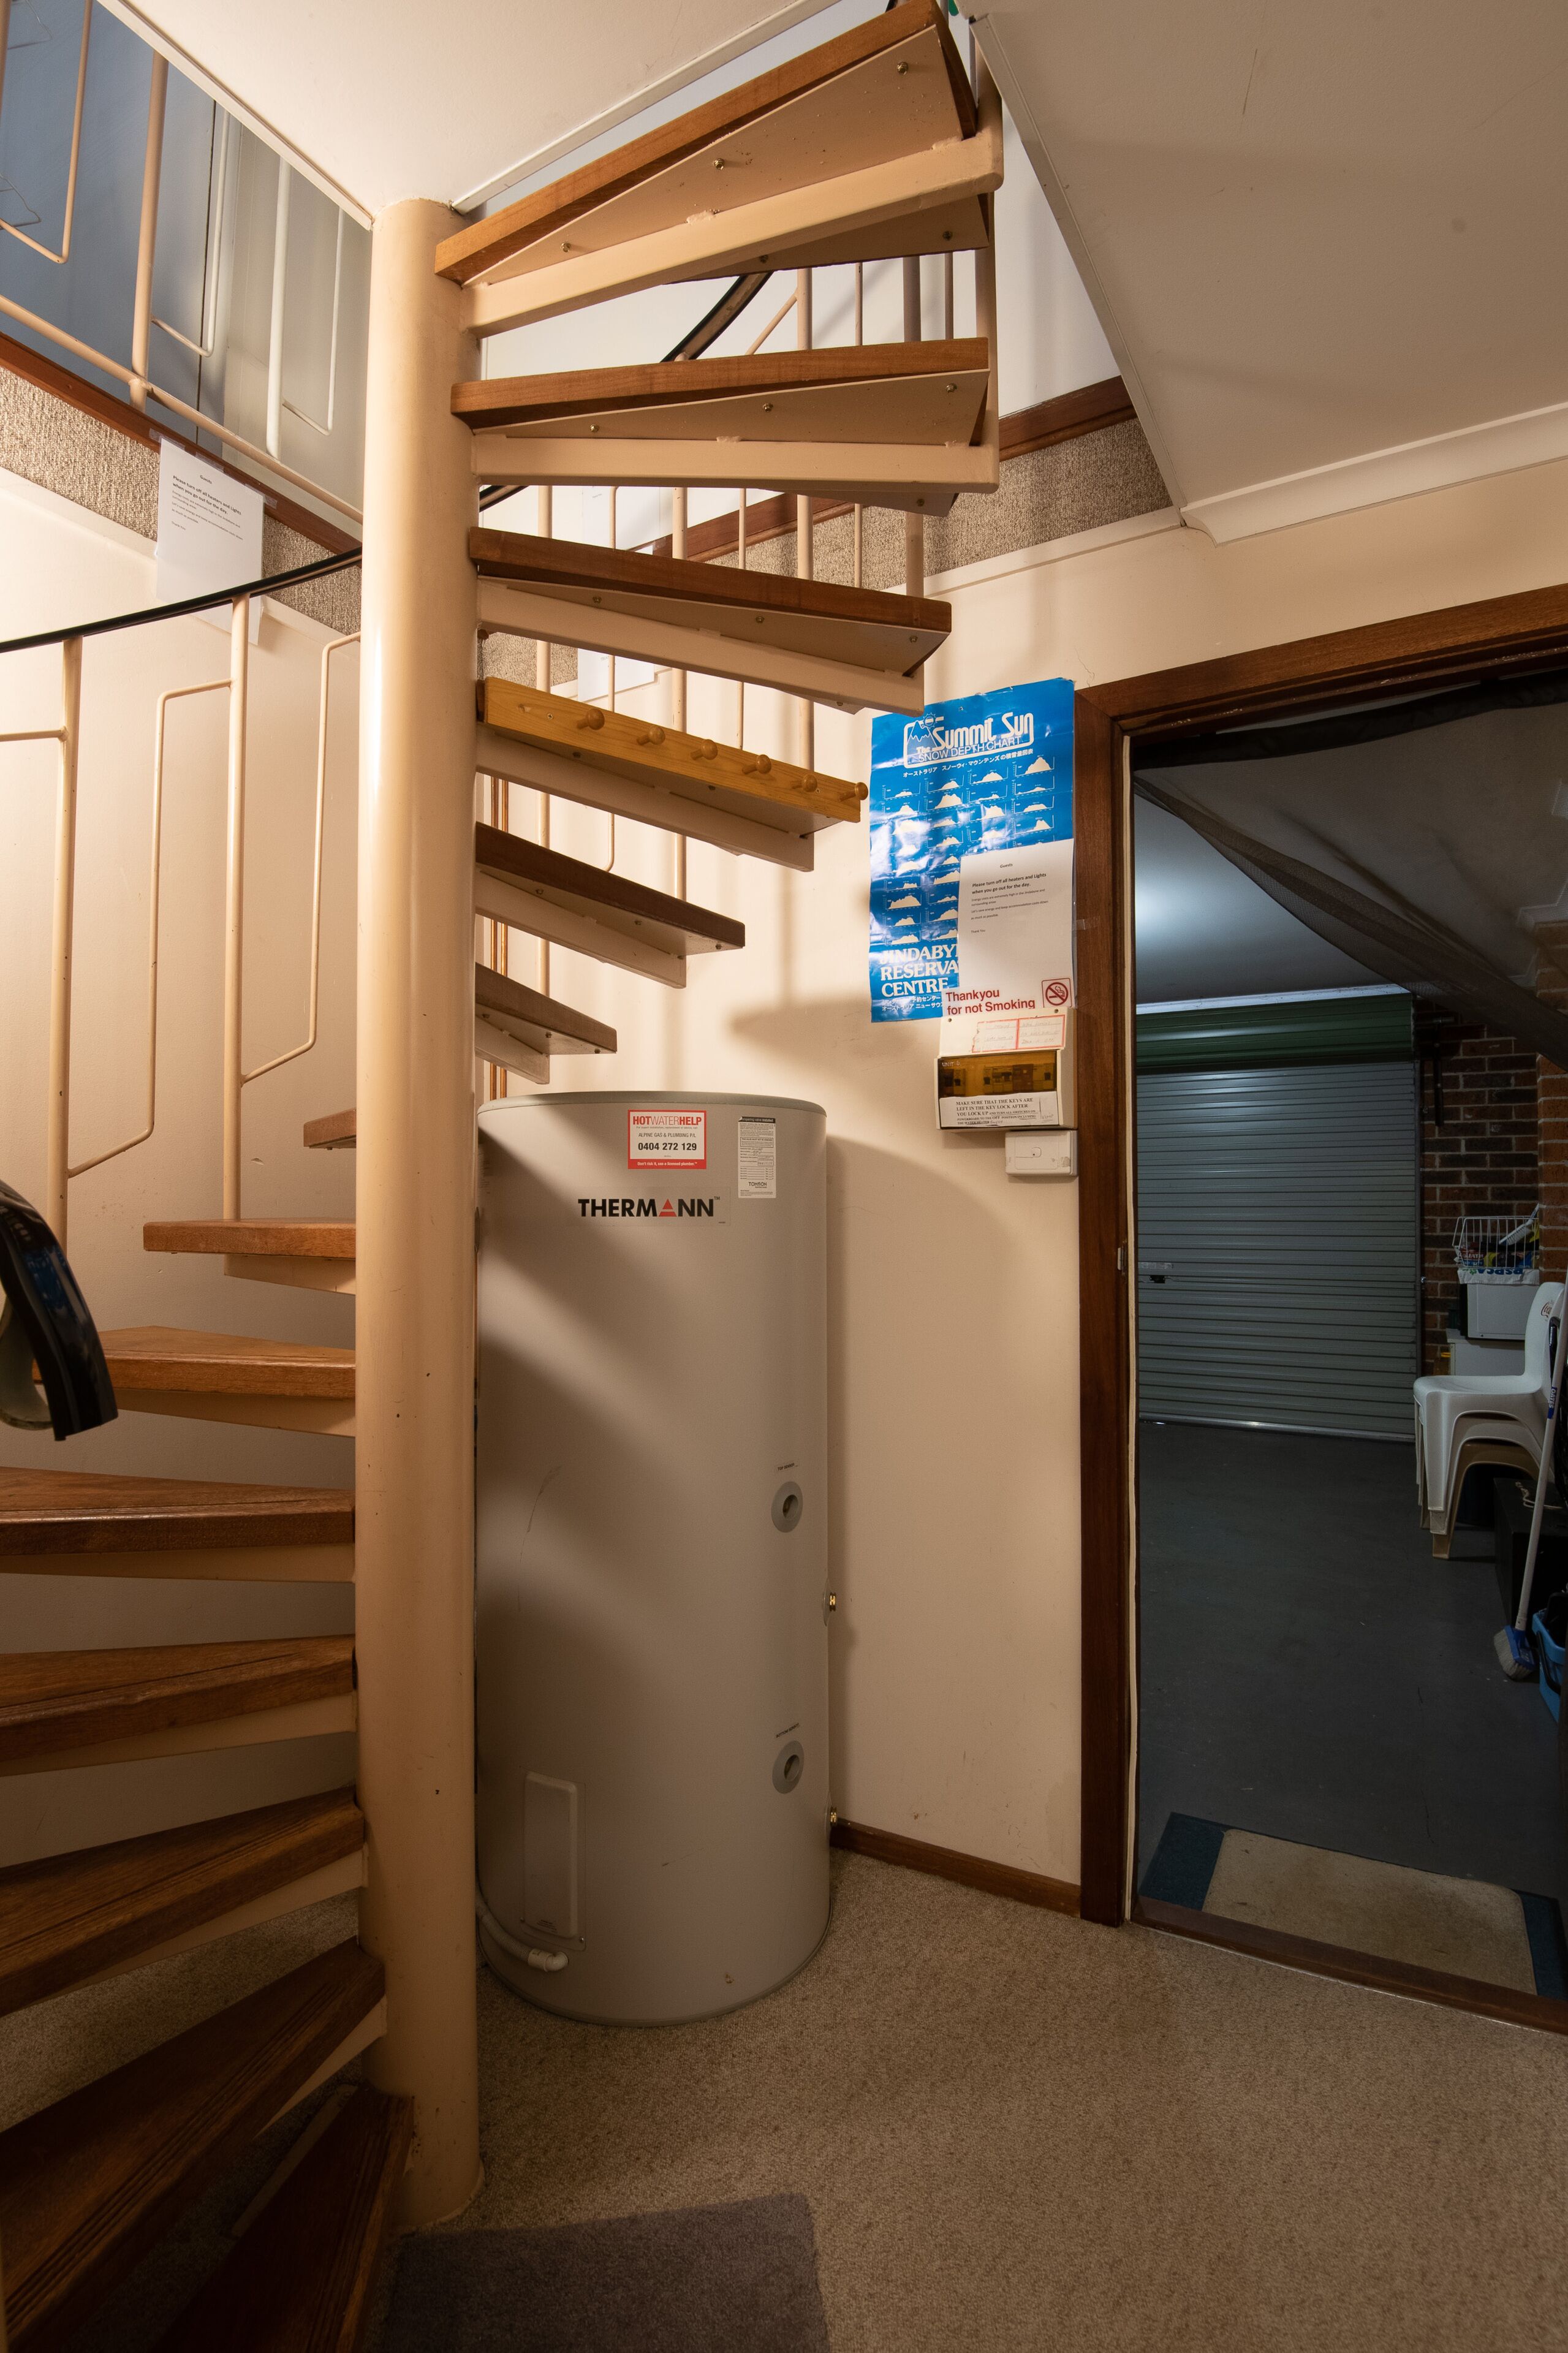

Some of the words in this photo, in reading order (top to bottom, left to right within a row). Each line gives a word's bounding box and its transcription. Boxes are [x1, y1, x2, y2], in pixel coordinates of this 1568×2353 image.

[173, 482, 184, 491] when
[173, 475, 186, 485] Please
[208, 494, 222, 504] heaters
[933, 717, 997, 750] Summit
[1001, 712, 1034, 739] Sun
[918, 749, 949, 762] SNOW
[951, 745, 984, 757] DEPTH
[987, 736, 1021, 750] CHART
[903, 767, 937, 778] オーストラリア
[879, 944, 958, 964] JINDABY
[881, 960, 959, 980] RESERVA
[945, 990, 999, 1002] Thankyou
[947, 1006, 962, 1015] for
[965, 1004, 982, 1014] not
[985, 999, 1036, 1012] Smoking
[633, 1116, 702, 1125] HOTWATERHELP
[578, 1199, 714, 1217] THERMANN
